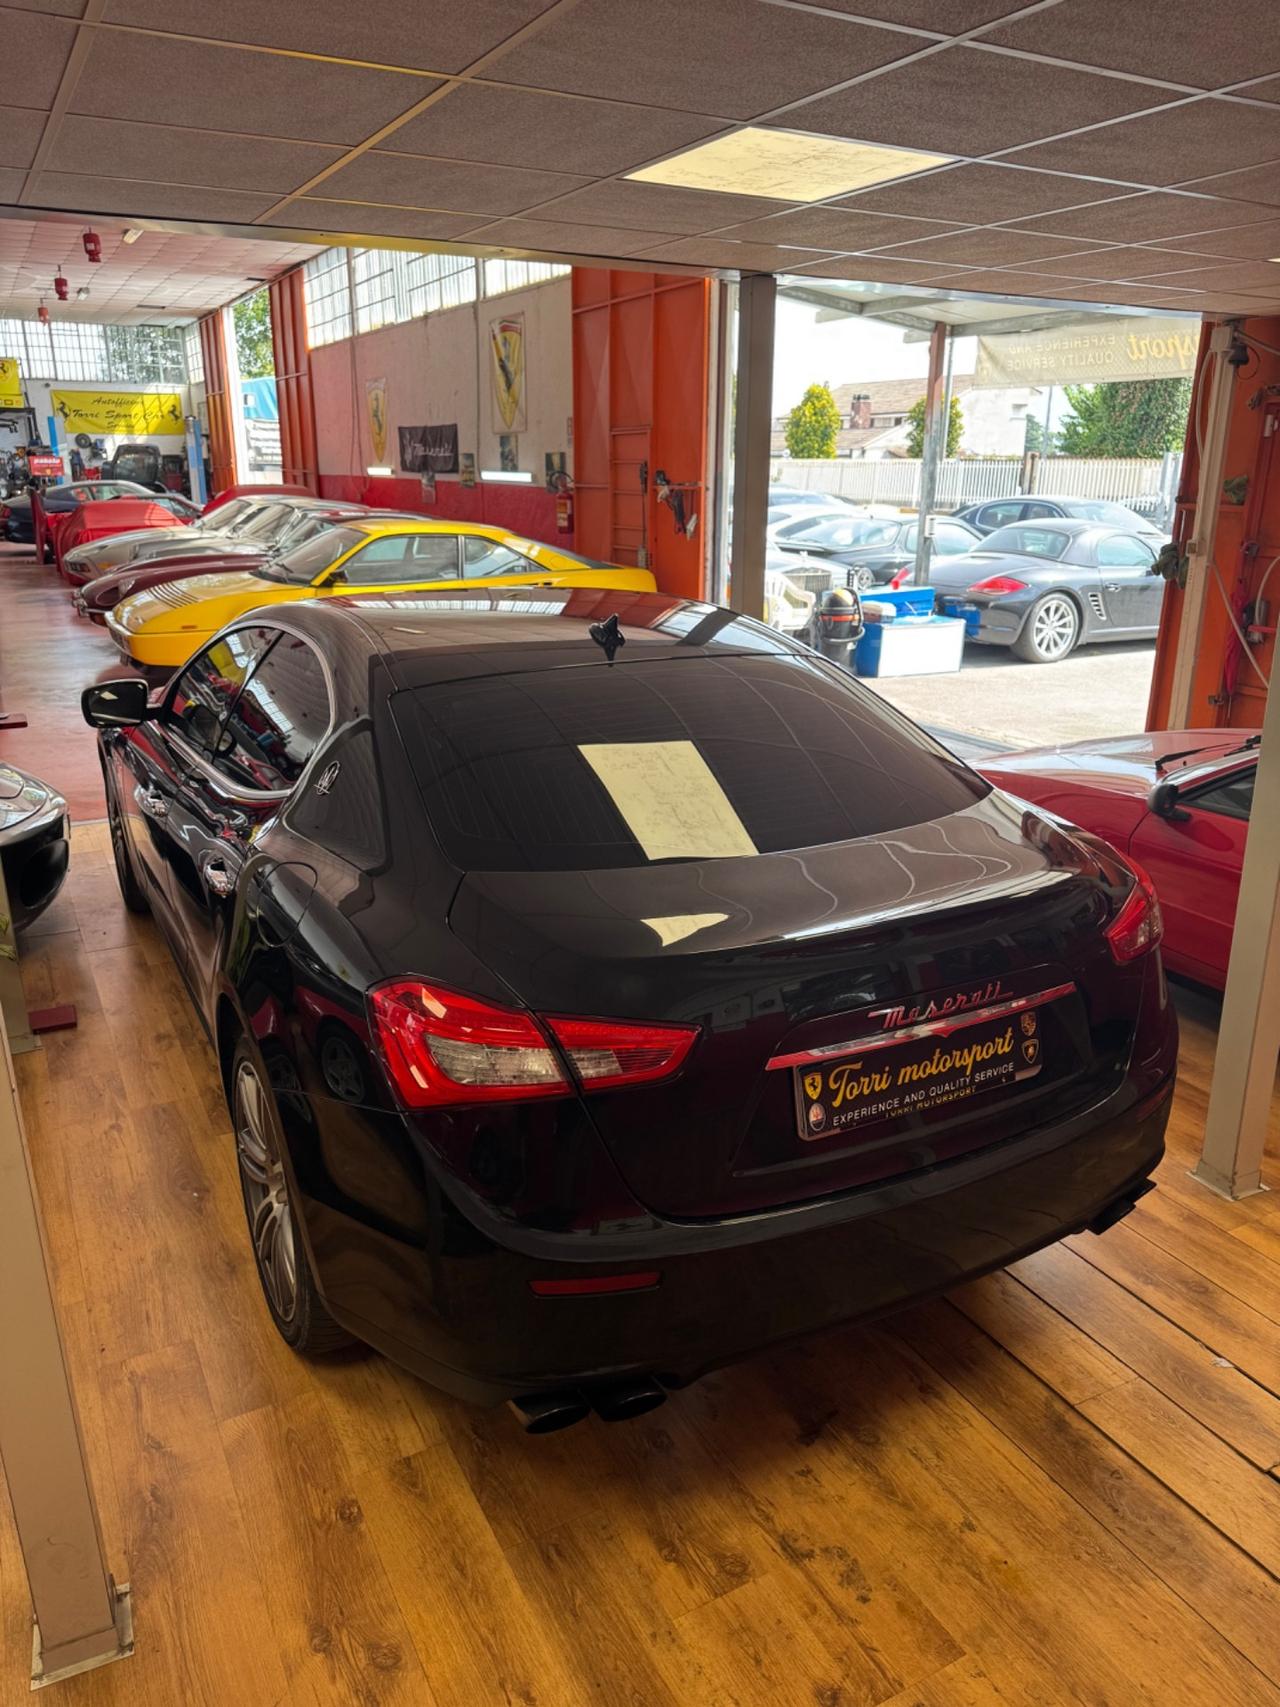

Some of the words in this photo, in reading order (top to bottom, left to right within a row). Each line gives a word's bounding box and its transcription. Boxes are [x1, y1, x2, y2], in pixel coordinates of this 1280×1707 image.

[72, 409, 100, 419] Torri
[104, 409, 137, 421] Sport
[868, 981, 1014, 1029] Maserati
[829, 1061, 892, 1108] Torri
[897, 1028, 1014, 1086] motorsport
[832, 1097, 901, 1127] EXPERIENCE
[903, 1090, 927, 1105] AND
[929, 1077, 971, 1098] QUALITY
[974, 1062, 1015, 1084] SERVICE
